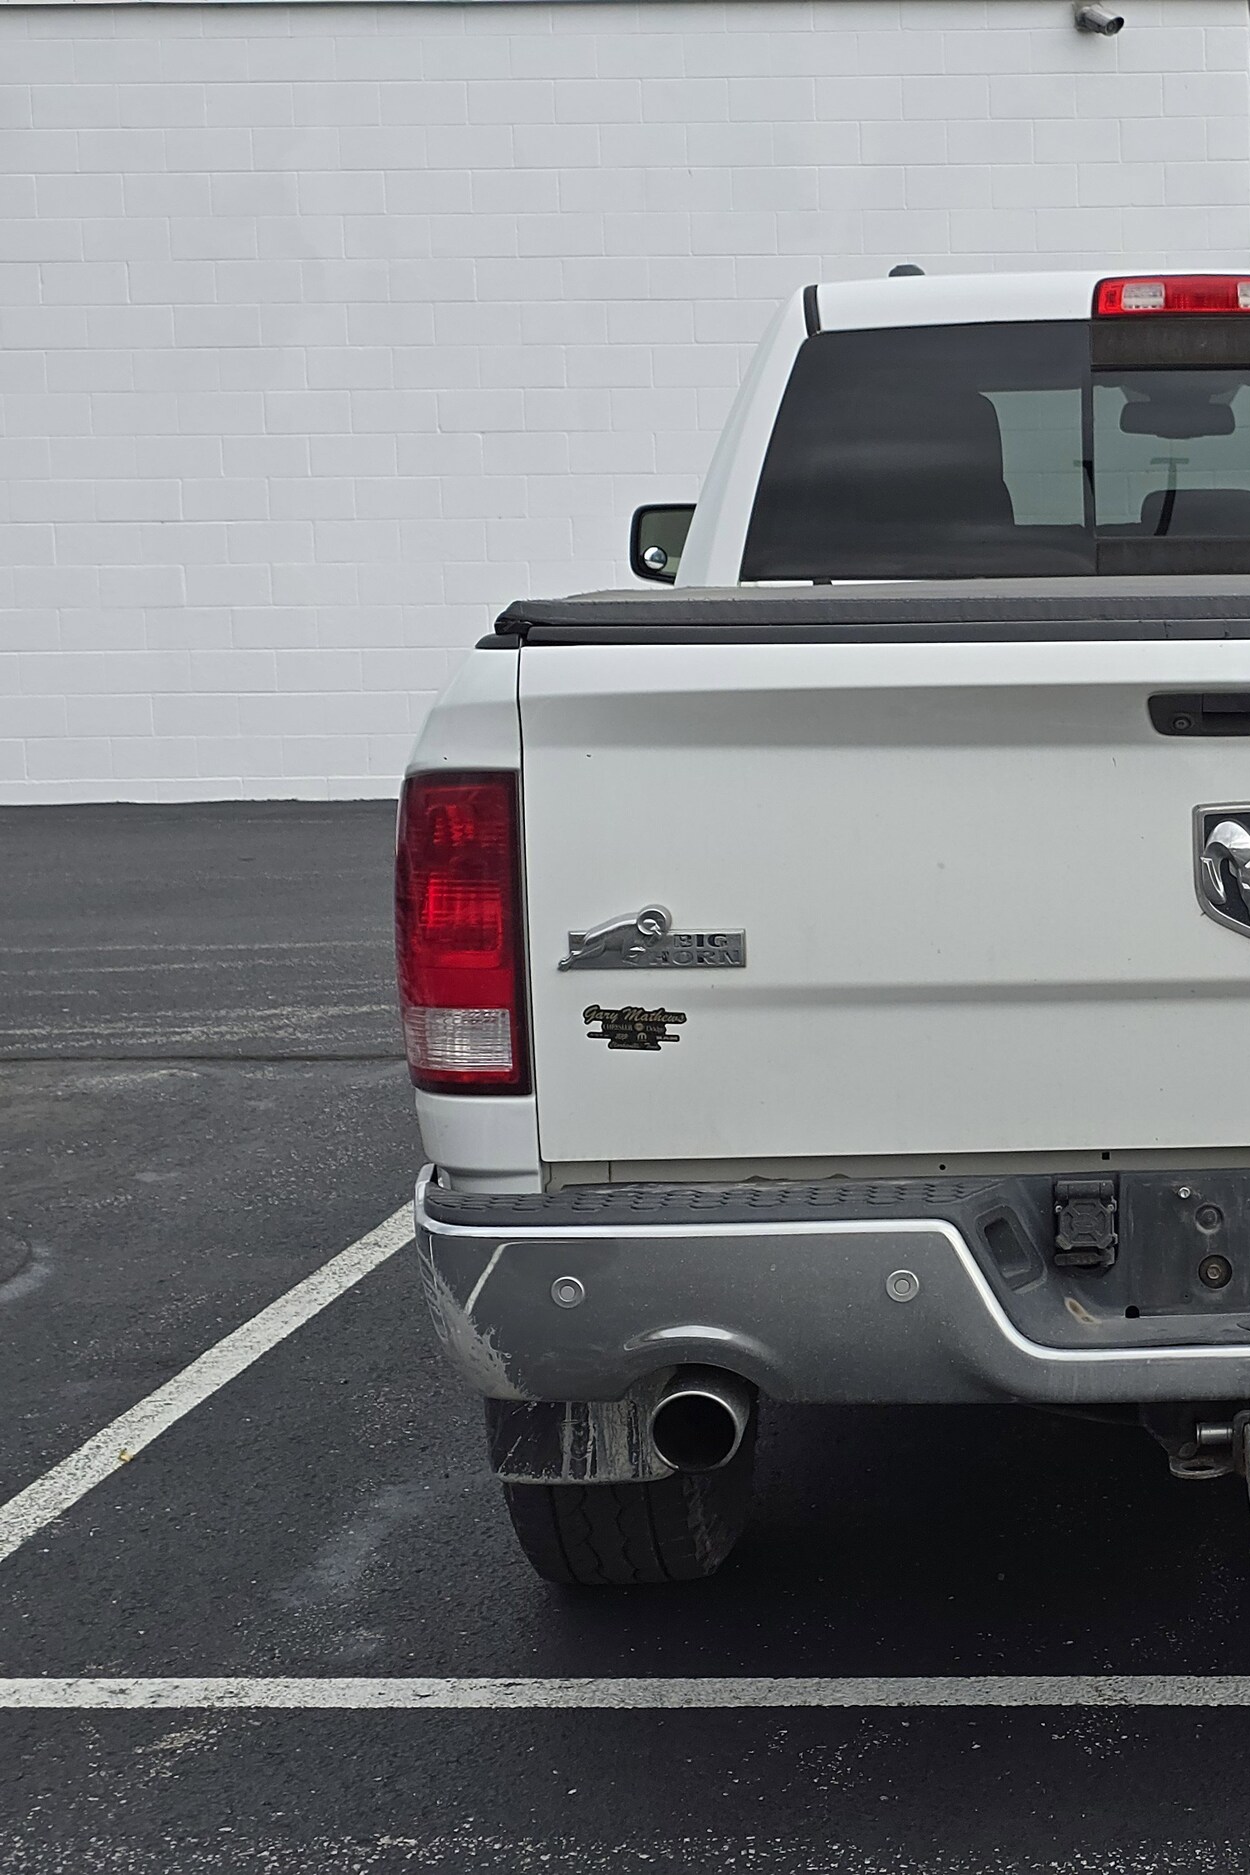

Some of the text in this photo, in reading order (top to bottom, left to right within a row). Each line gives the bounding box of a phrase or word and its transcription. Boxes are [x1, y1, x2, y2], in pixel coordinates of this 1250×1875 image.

[673, 933, 729, 949] BIG
[648, 950, 741, 966] HORN
[584, 1005, 685, 1024] Gary Mathews
